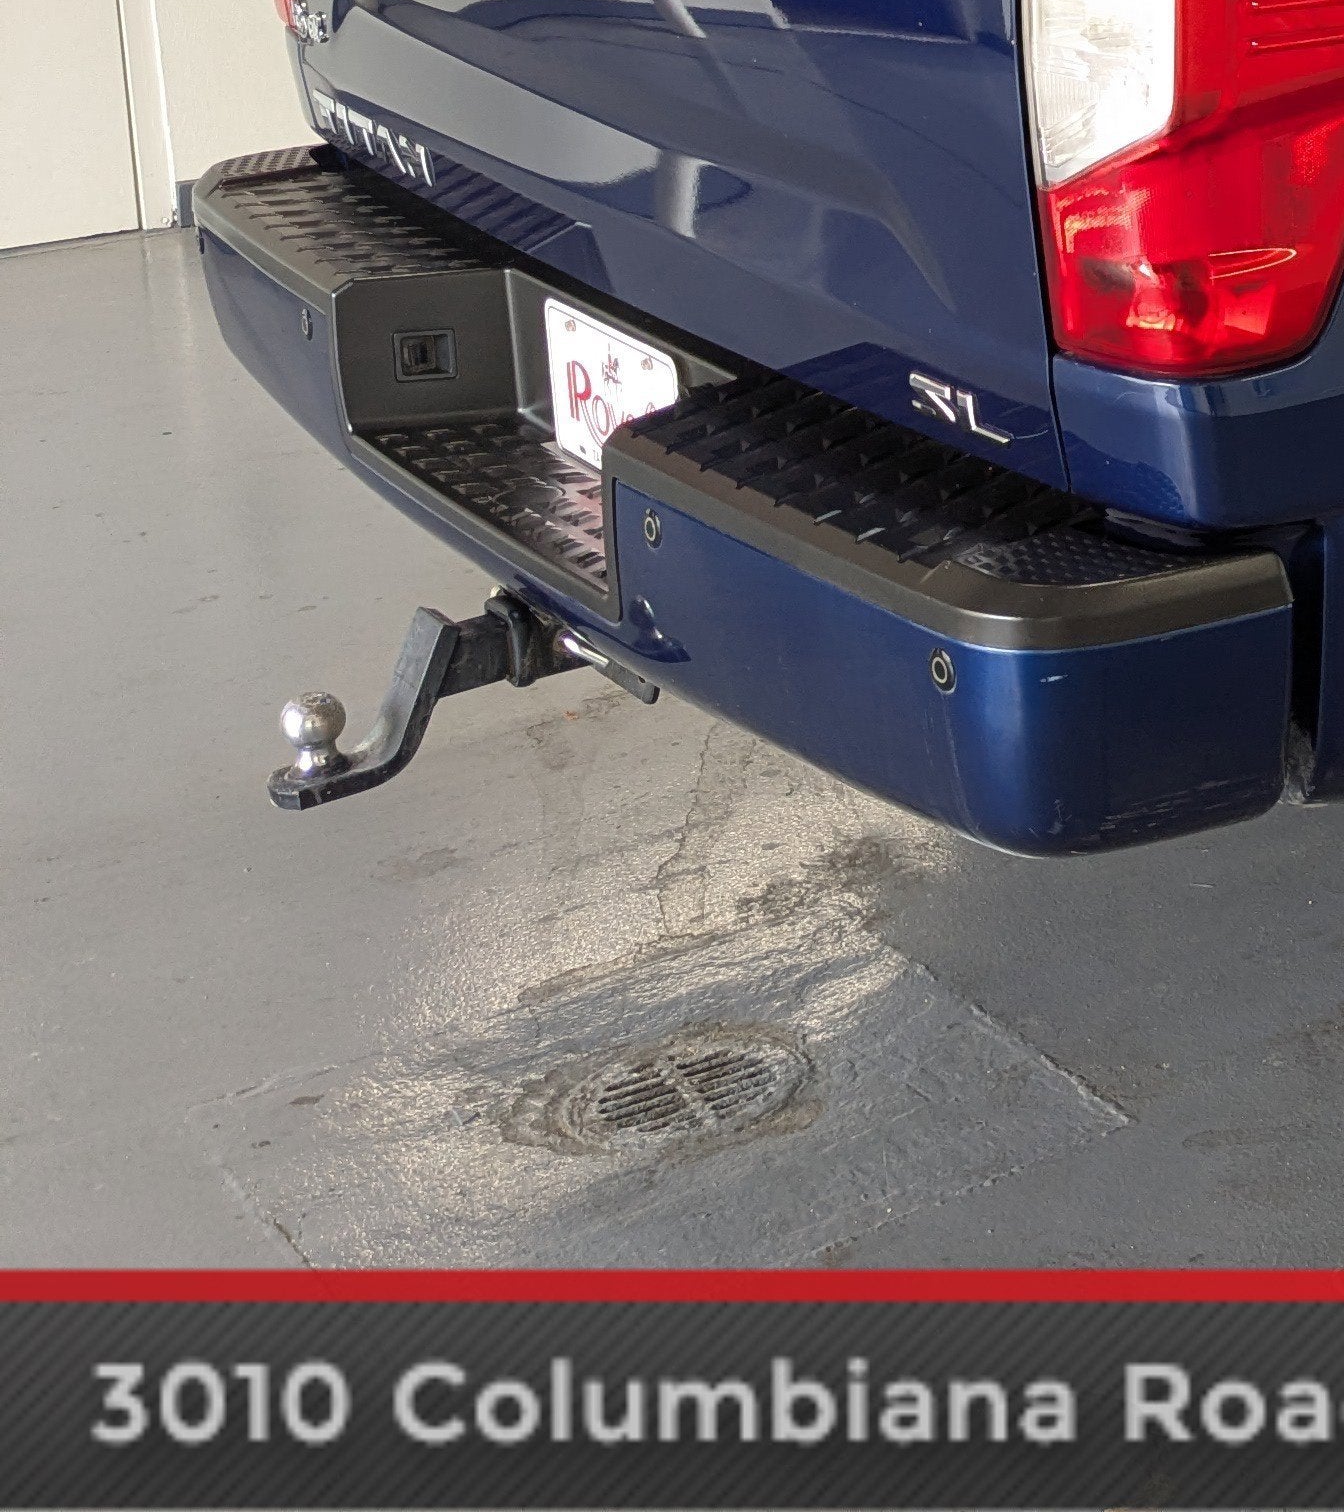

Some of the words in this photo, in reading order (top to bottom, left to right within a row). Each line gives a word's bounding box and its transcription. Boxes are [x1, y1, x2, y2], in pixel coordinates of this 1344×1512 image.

[312, 88, 437, 188] TITAN
[566, 359, 657, 446] Roy
[908, 370, 1015, 445] SL
